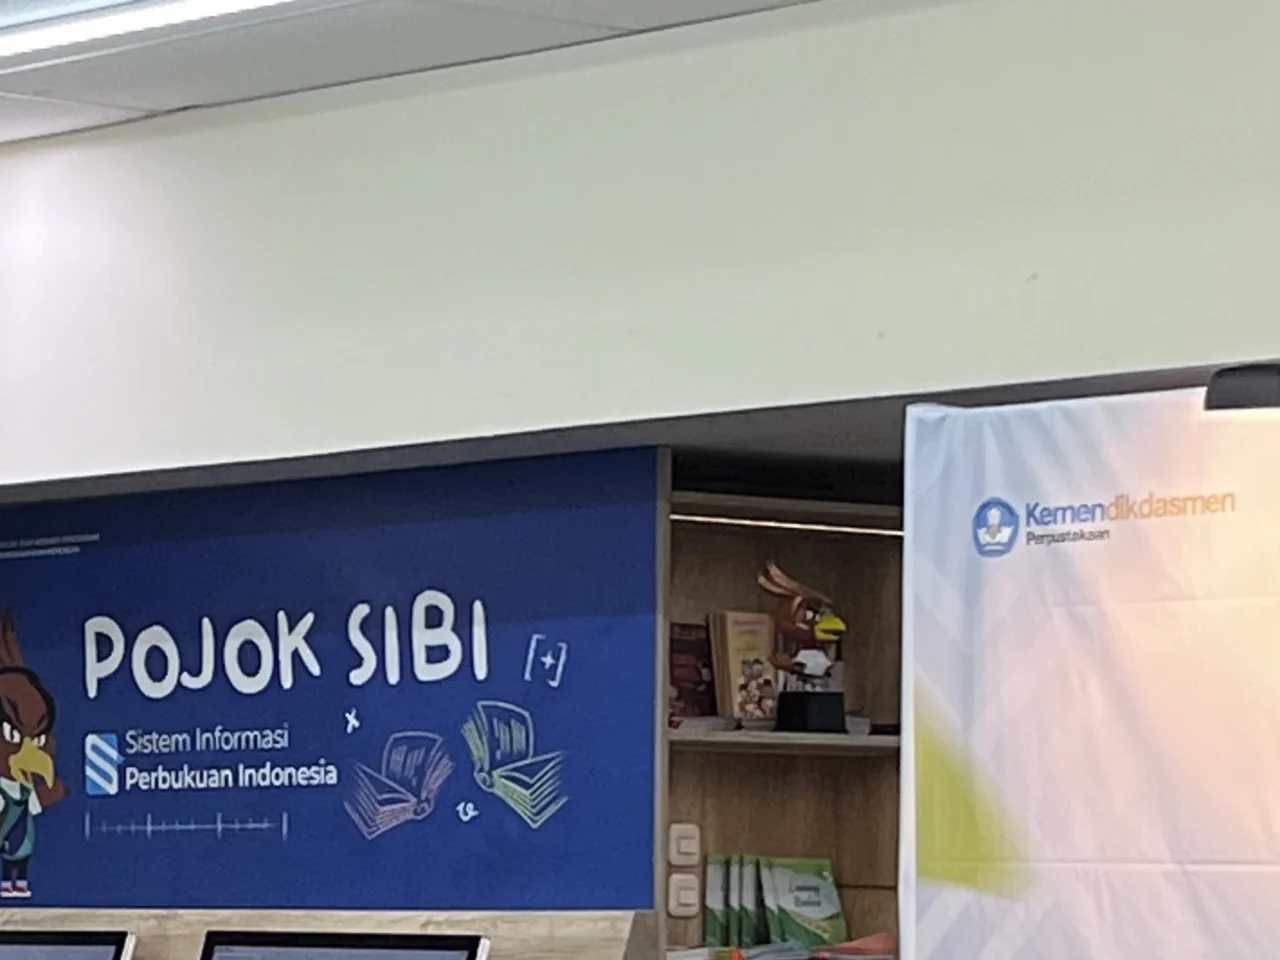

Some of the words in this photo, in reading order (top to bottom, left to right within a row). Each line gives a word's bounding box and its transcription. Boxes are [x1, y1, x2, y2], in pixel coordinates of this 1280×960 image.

[1025, 491, 1236, 527] Kemendikdasmen
[83, 609, 321, 699] POJOK
[347, 590, 489, 687] SIBI
[125, 728, 191, 754] Sistem
[195, 723, 289, 752] Informasi
[125, 763, 233, 791] Perbukuan
[238, 758, 338, 787] Indonesia
